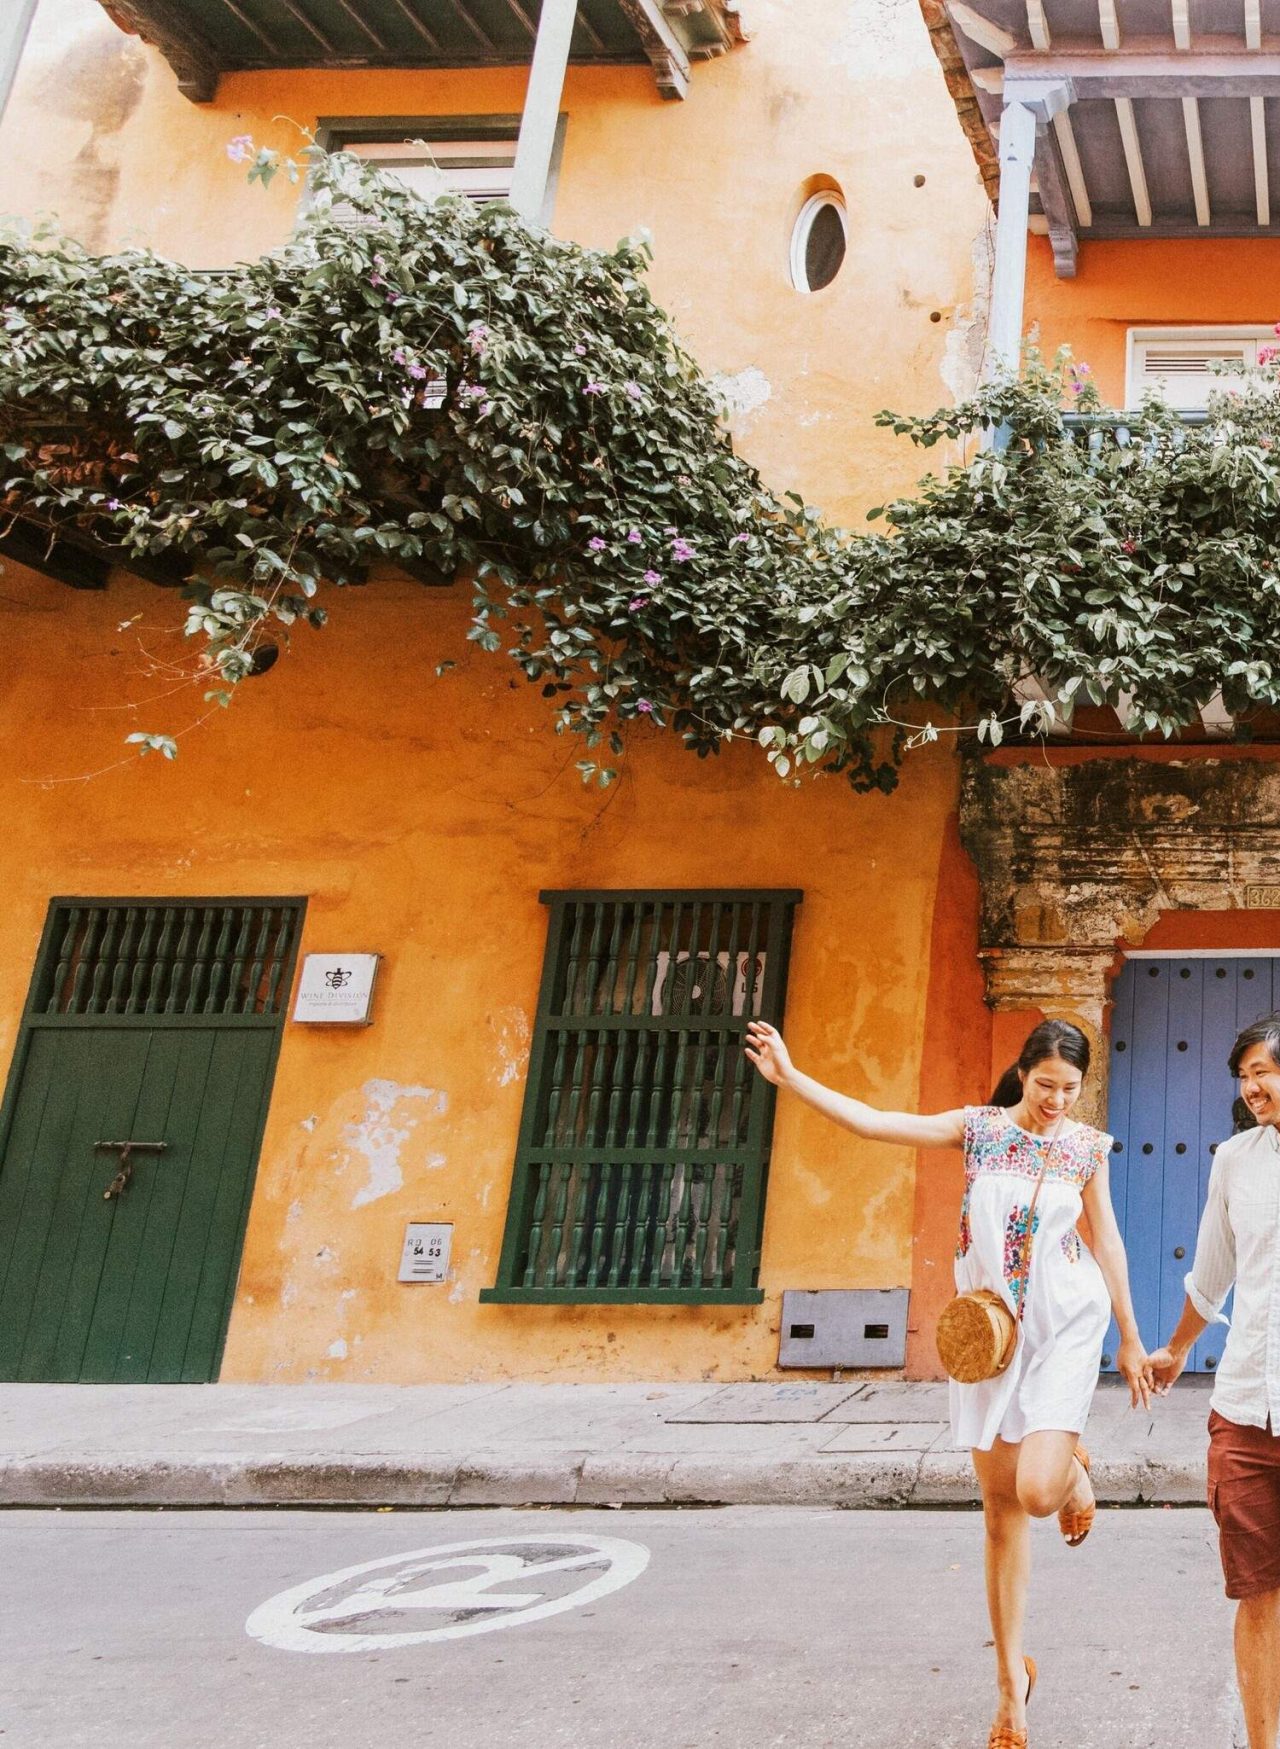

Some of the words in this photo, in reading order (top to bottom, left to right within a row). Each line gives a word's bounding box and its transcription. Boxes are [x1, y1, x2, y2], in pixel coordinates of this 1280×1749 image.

[301, 992, 323, 1000] WINE
[413, 1246, 424, 1256] 54
[429, 1247, 441, 1258] 53
